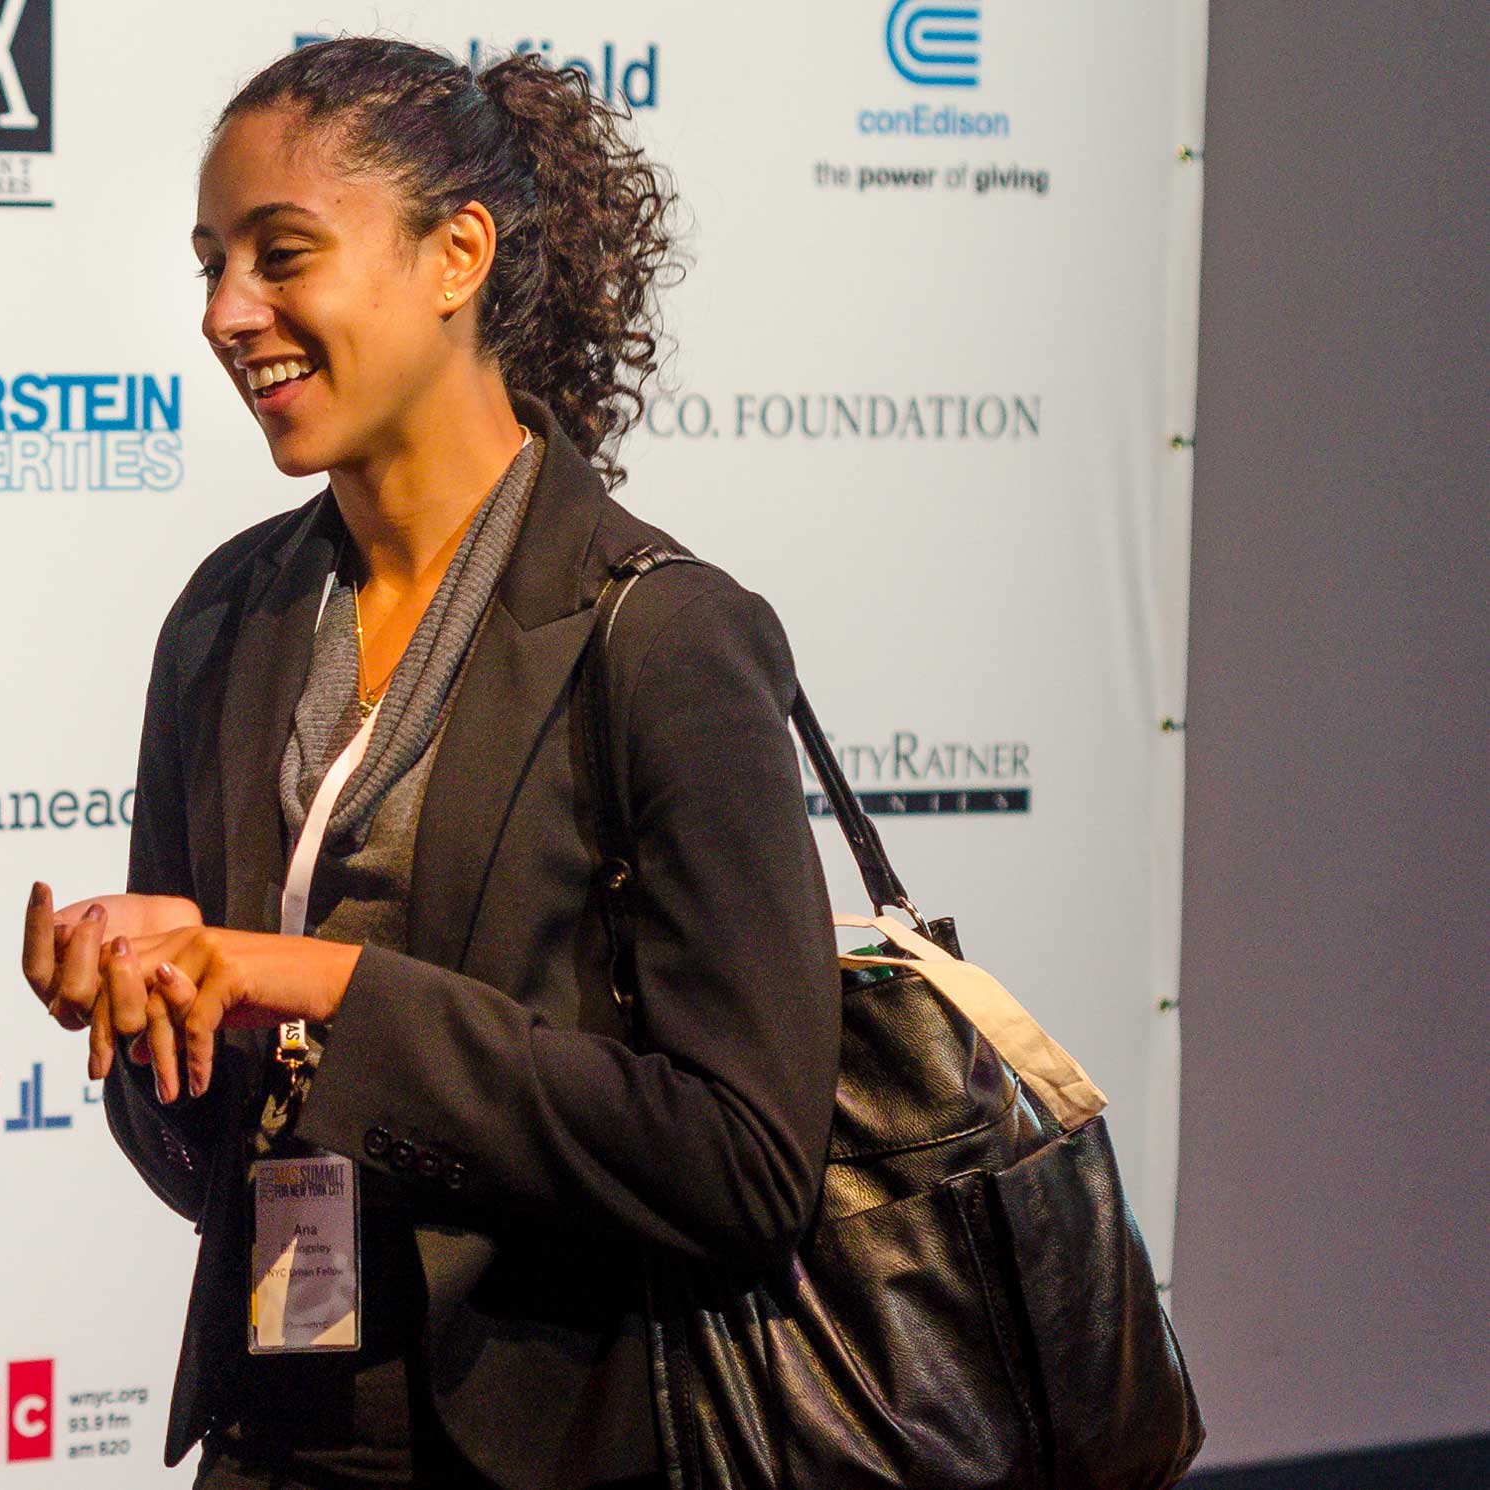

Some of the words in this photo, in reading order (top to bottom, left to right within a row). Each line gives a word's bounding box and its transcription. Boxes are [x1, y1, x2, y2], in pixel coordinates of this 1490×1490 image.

[857, 104, 1010, 137] conEdison
[814, 162, 851, 186] the
[858, 166, 937, 194] power
[946, 165, 967, 188] of
[974, 164, 1051, 197] giving
[733, 394, 1041, 440] FOUNDATION
[294, 1223, 318, 1236] Ana
[68, 1387, 149, 1409] wnyc.org
[107, 1412, 131, 1429] fm
[68, 1444, 95, 1459] am
